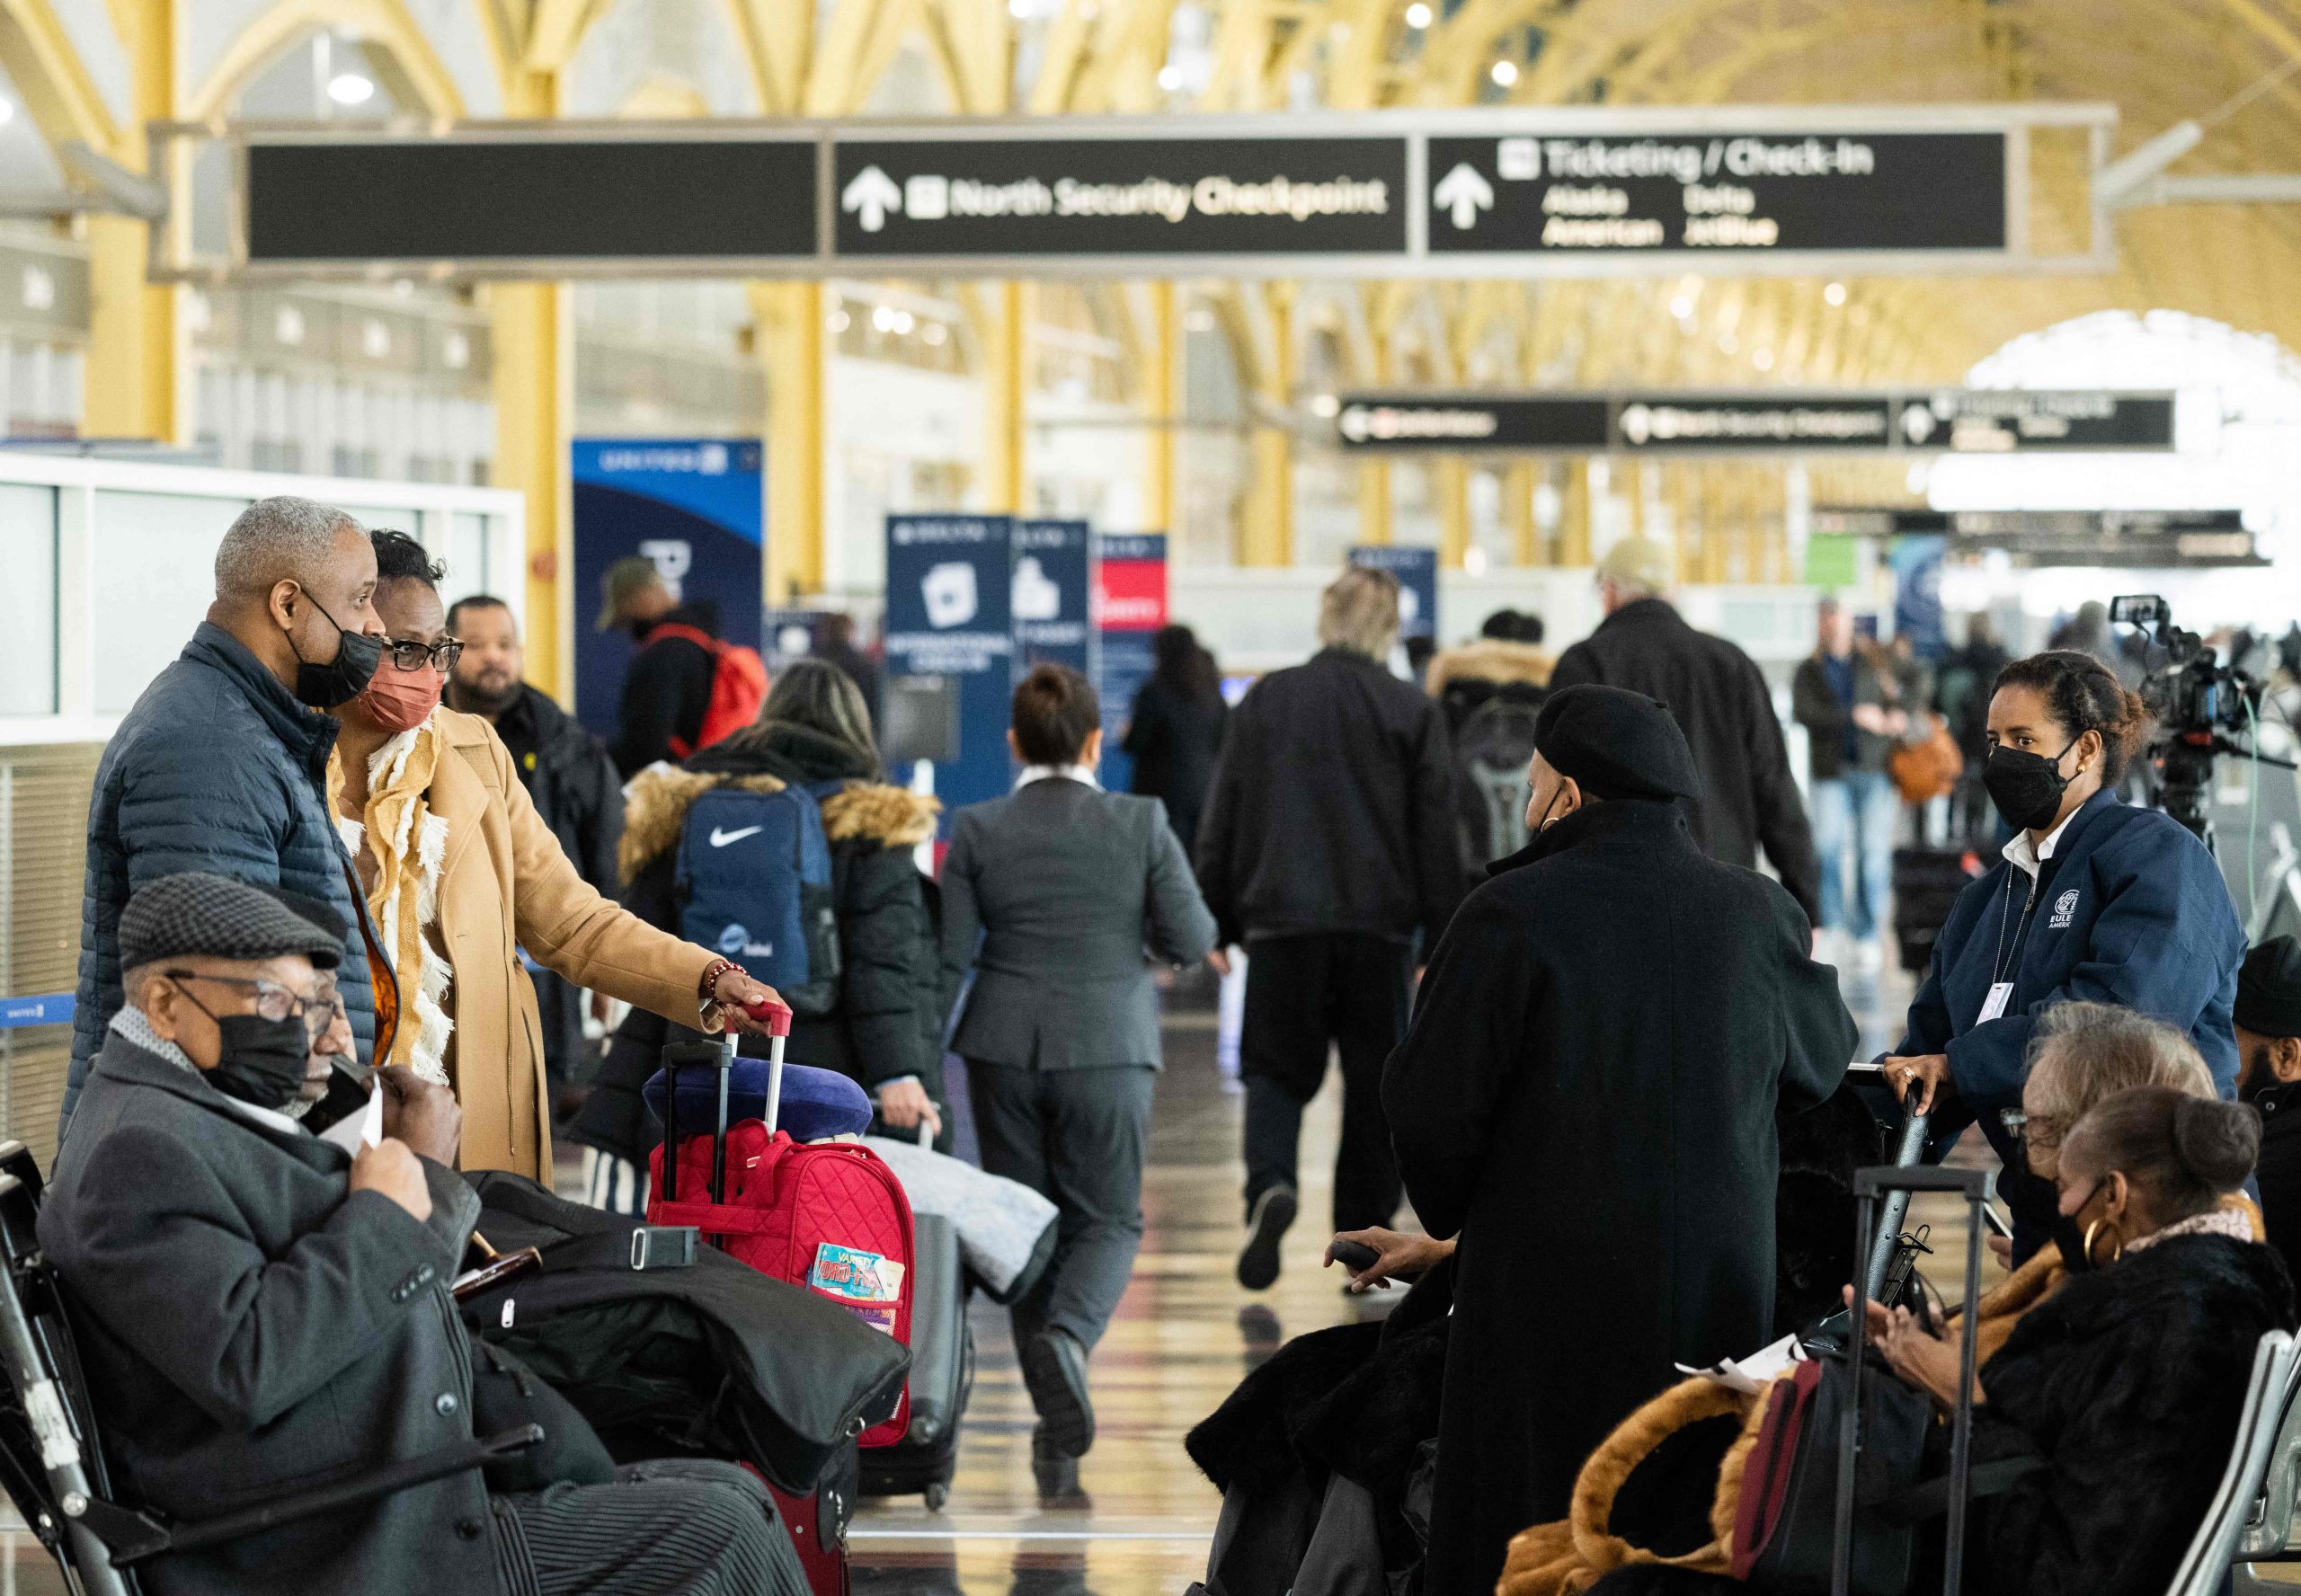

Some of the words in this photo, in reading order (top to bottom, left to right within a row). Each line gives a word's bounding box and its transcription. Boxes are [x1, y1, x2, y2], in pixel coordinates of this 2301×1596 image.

[1542, 138, 1701, 183] Ticketing
[1725, 138, 1875, 176] Check-In
[949, 176, 1053, 216] North
[1053, 175, 1191, 223] Security
[1193, 174, 1388, 221] Checkpoint
[1541, 185, 1630, 216] Alaska
[1682, 183, 1755, 216] Delta
[1541, 216, 1665, 247] American
[599, 449, 693, 471] UNITED
[838, 1251, 875, 1269] VARIETY
